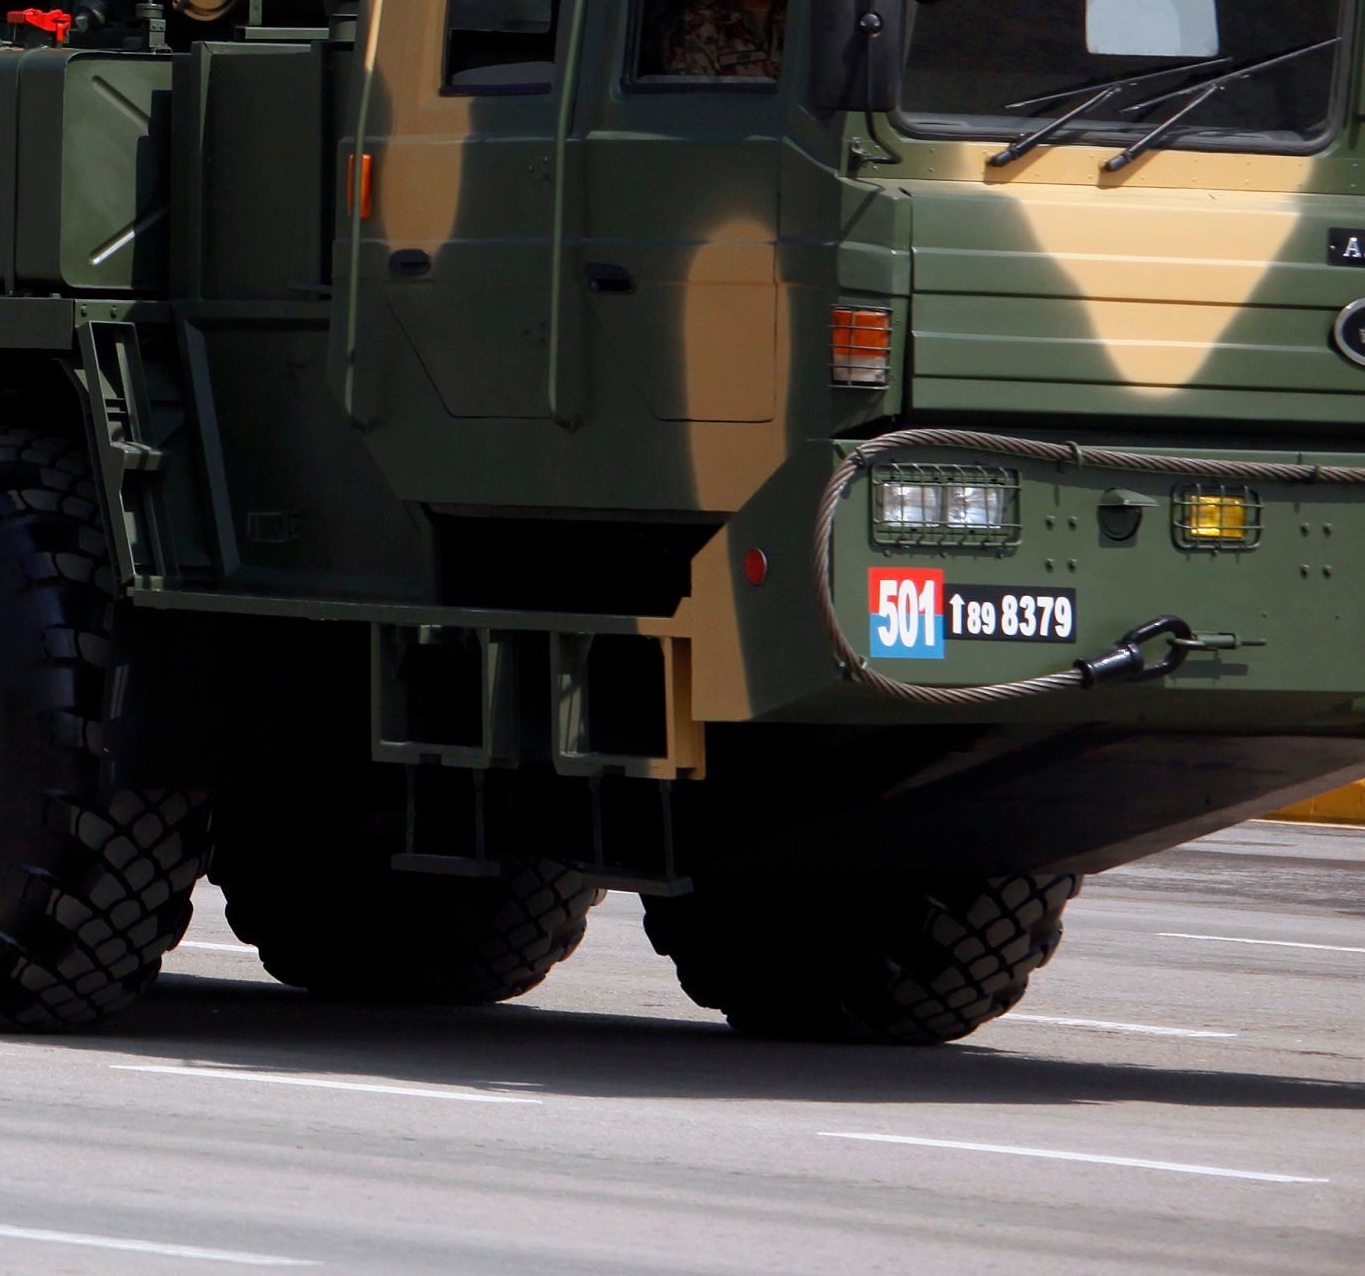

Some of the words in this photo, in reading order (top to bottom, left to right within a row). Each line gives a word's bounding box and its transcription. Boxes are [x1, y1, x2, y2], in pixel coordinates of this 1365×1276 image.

[878, 579, 935, 648] 501
[967, 601, 996, 635] 89
[1001, 595, 1073, 638] 8379
